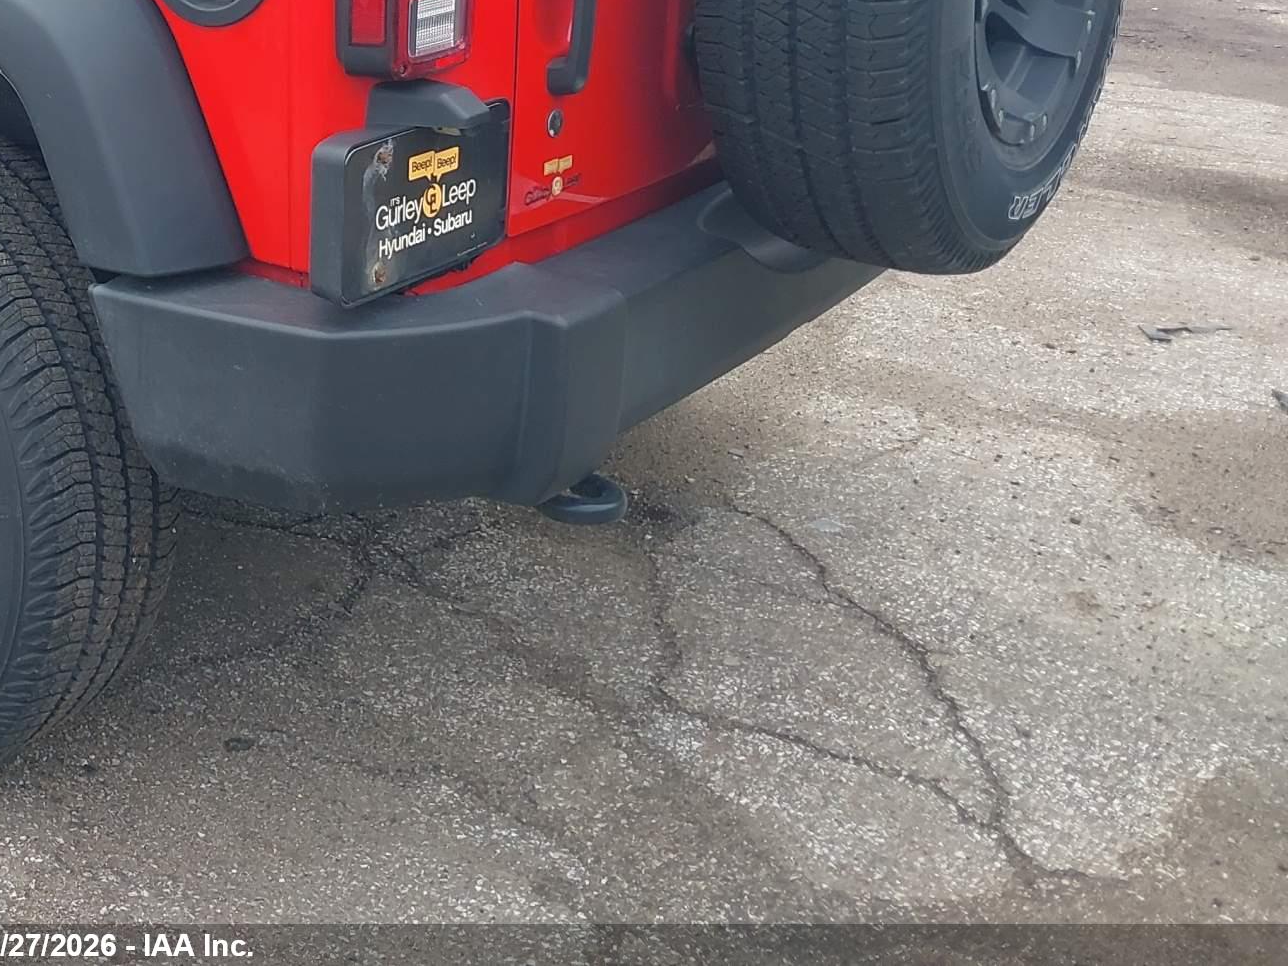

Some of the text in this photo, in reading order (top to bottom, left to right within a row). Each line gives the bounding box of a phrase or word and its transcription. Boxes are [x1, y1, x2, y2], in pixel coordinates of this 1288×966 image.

[411, 153, 457, 173] Beep! Beep!
[375, 195, 424, 231] Gurley
[442, 178, 477, 208] Leep
[378, 222, 426, 260] Hyundai
[433, 209, 473, 237] Subaru
